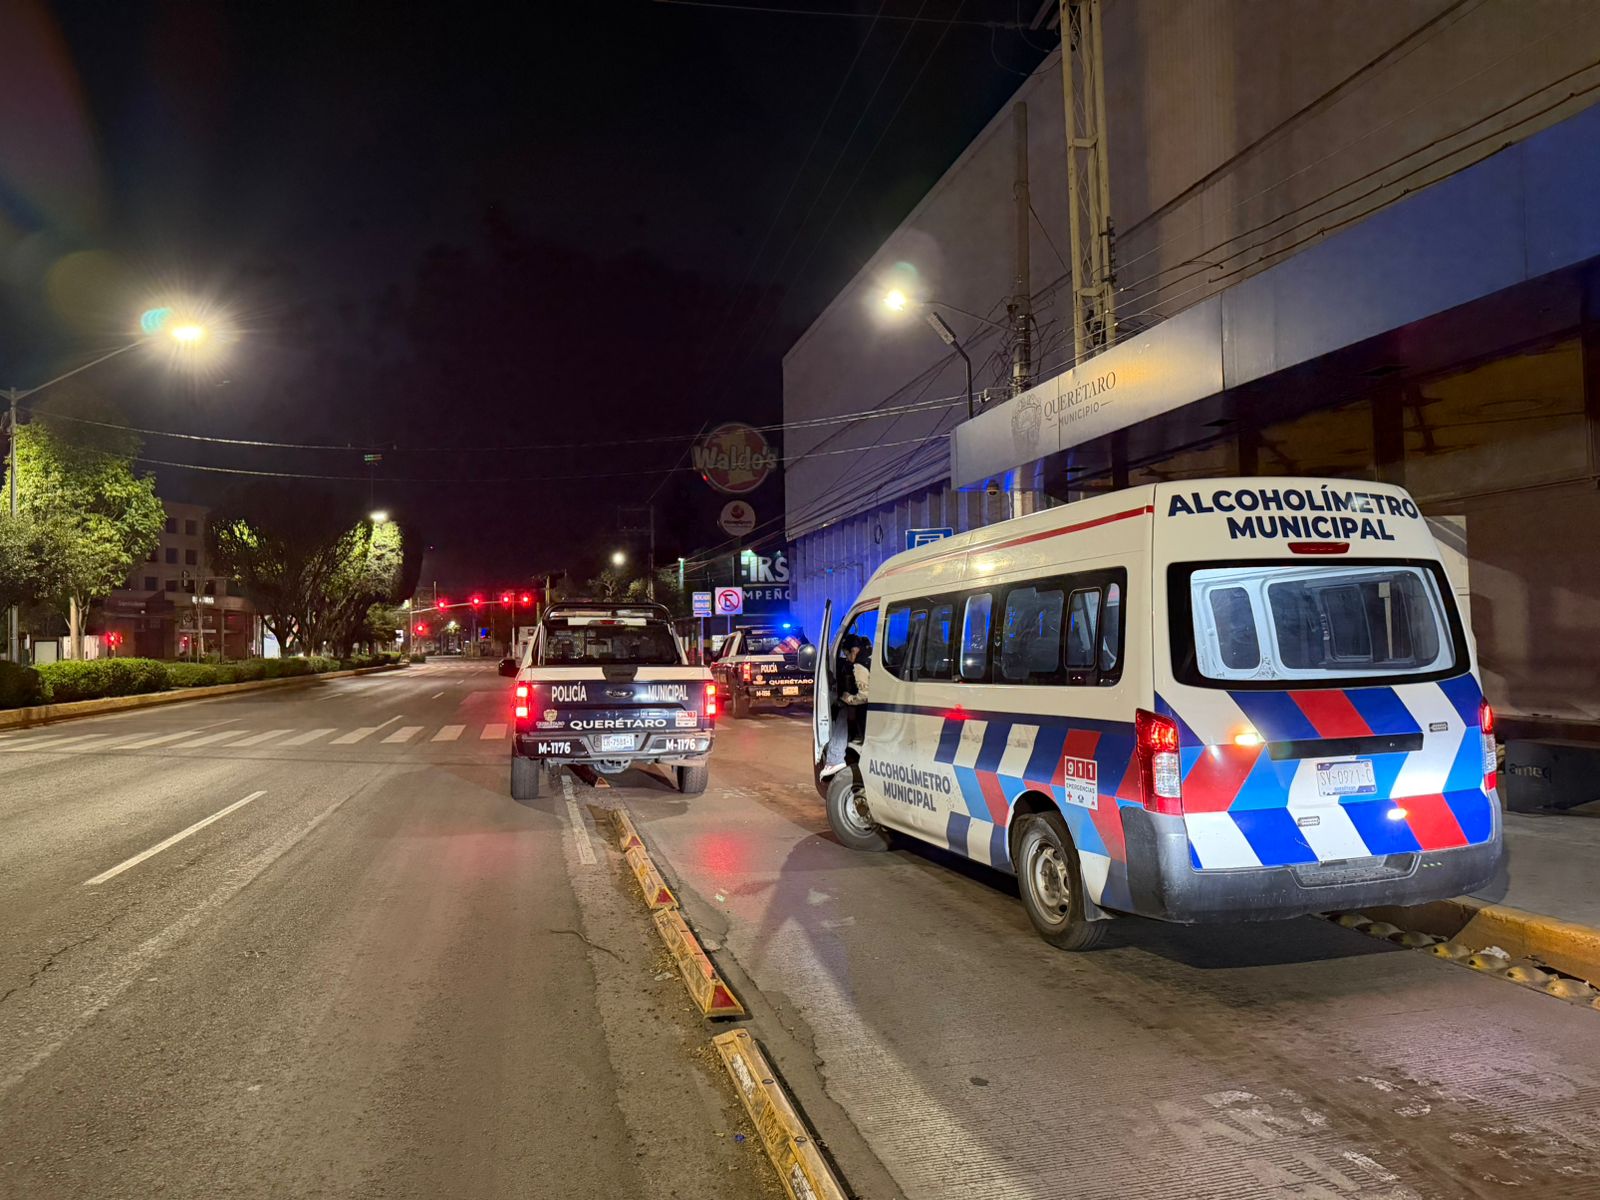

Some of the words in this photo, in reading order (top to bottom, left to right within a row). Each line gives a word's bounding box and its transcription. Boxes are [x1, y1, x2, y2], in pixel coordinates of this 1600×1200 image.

[1044, 371, 1116, 420] QUERÉTARO
[1060, 402, 1099, 427] MUNICIPIO
[692, 445, 778, 471] Waldo's
[1168, 485, 1419, 519] ALCOHOLÍMETRO
[1226, 516, 1395, 541] MUNICIPAL
[551, 681, 587, 702] POLICÍA
[648, 684, 689, 701] MUNICIPAL
[768, 678, 814, 686] QUERÉTARO
[569, 717, 667, 730] QUERÉTARO
[538, 742, 571, 754] M-1176
[665, 739, 696, 751] M-1176
[869, 759, 951, 795] ALCOHOLÍMETRO
[1067, 761, 1094, 778] 911
[883, 781, 937, 812] MUNICIPAL
